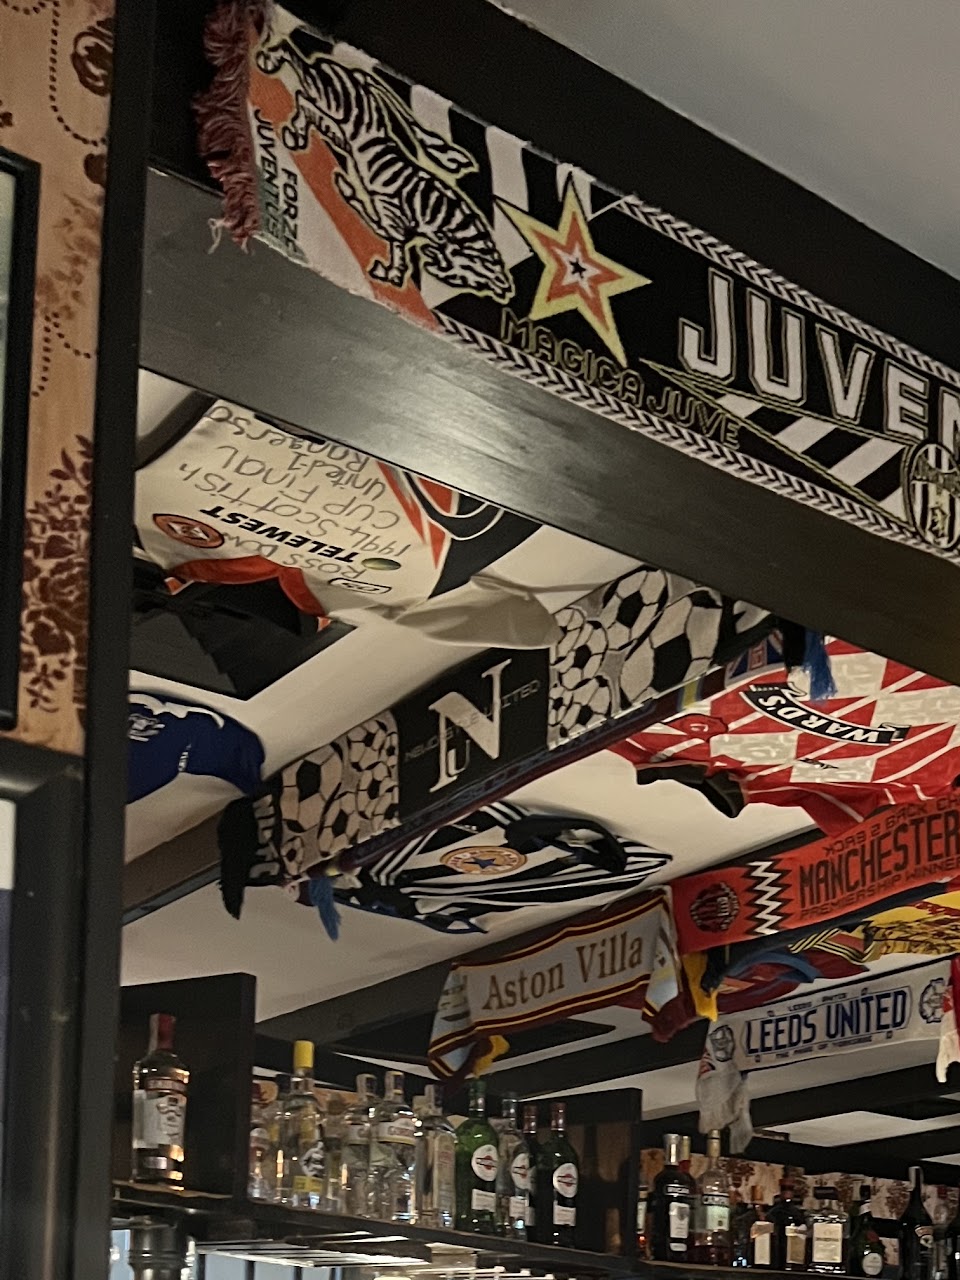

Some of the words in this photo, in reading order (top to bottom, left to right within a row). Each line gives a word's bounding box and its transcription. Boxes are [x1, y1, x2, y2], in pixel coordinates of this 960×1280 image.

[501, 307, 644, 408] MAGICA
[646, 386, 740, 450] JUVE
[199, 505, 359, 563] TELEWEST
[323, 494, 401, 531] CUP
[348, 526, 412, 558] 1994
[428, 658, 513, 793] N
[756, 693, 880, 744] WARD'S
[801, 873, 902, 921] PREMIERSHIP
[482, 961, 566, 1010] Aston
[576, 931, 644, 983] Villa
[746, 1008, 818, 1055] LEEDS
[826, 989, 907, 1039] UNITED
